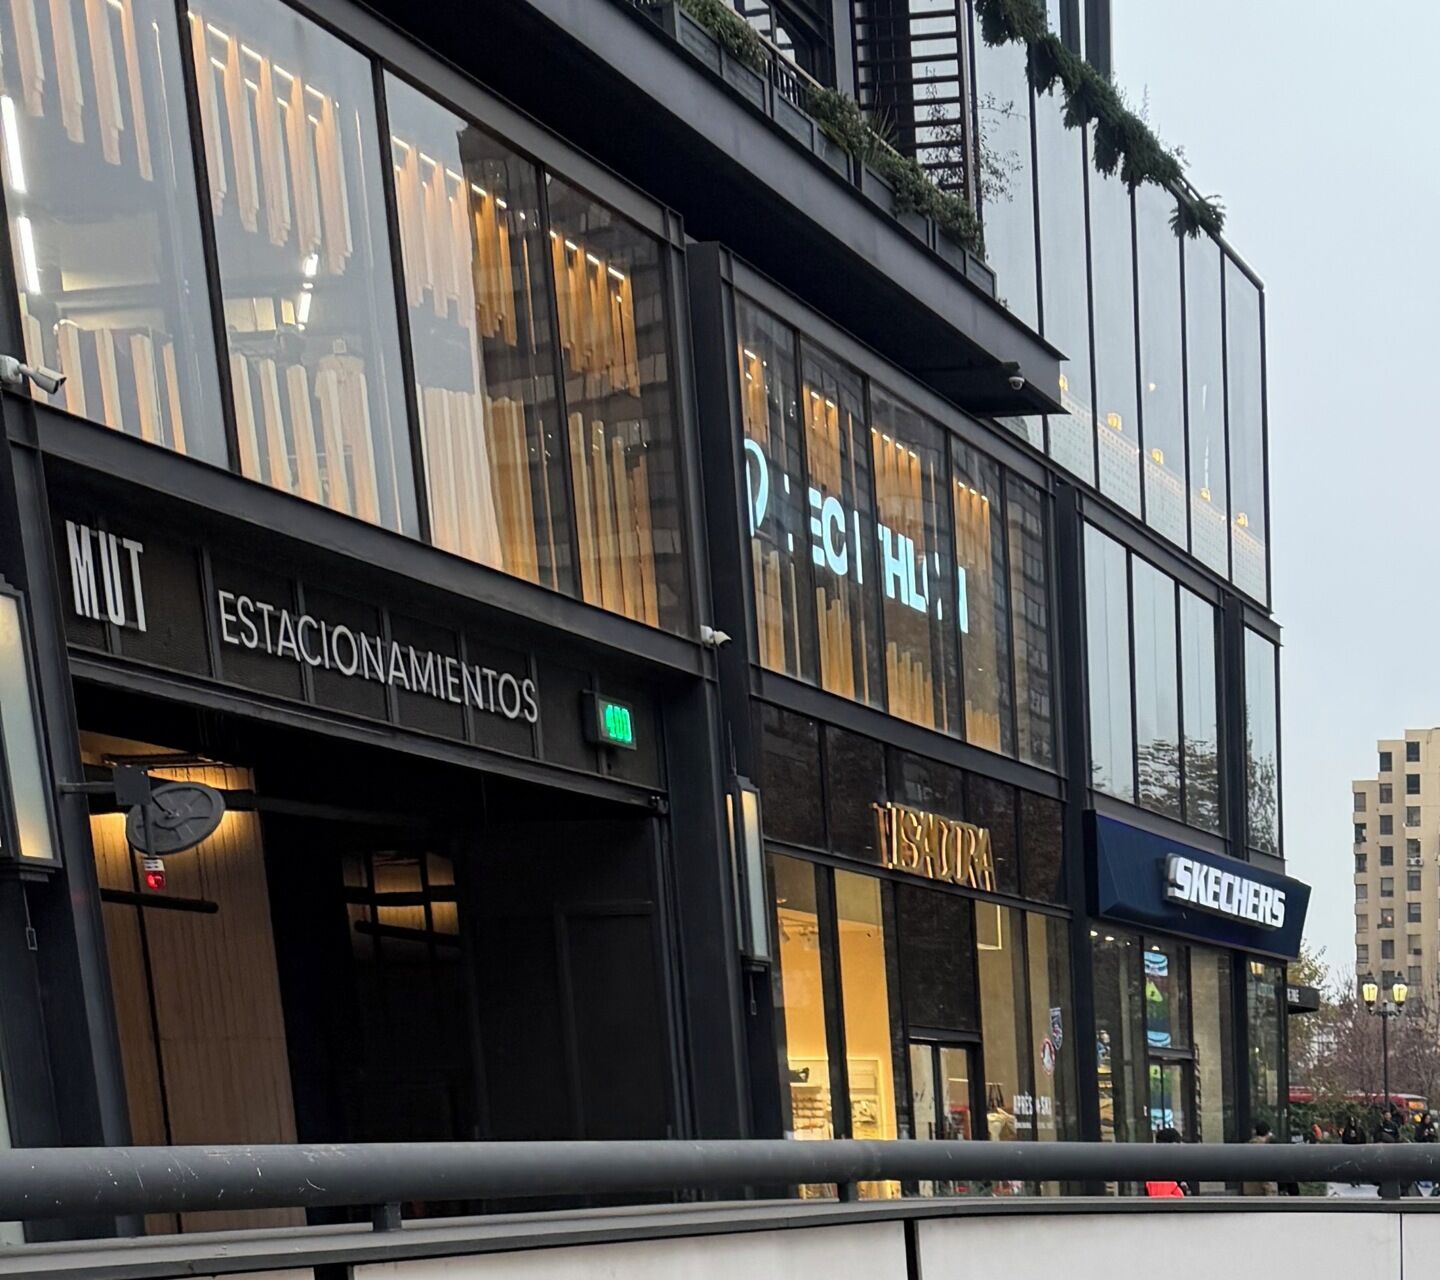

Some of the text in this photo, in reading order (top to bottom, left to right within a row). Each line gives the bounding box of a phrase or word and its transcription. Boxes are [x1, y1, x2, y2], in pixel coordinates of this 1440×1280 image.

[65, 519, 148, 633] MUT
[217, 590, 539, 724] ESTACIONAMIENTOS
[1172, 853, 1286, 928] SKECHERS
